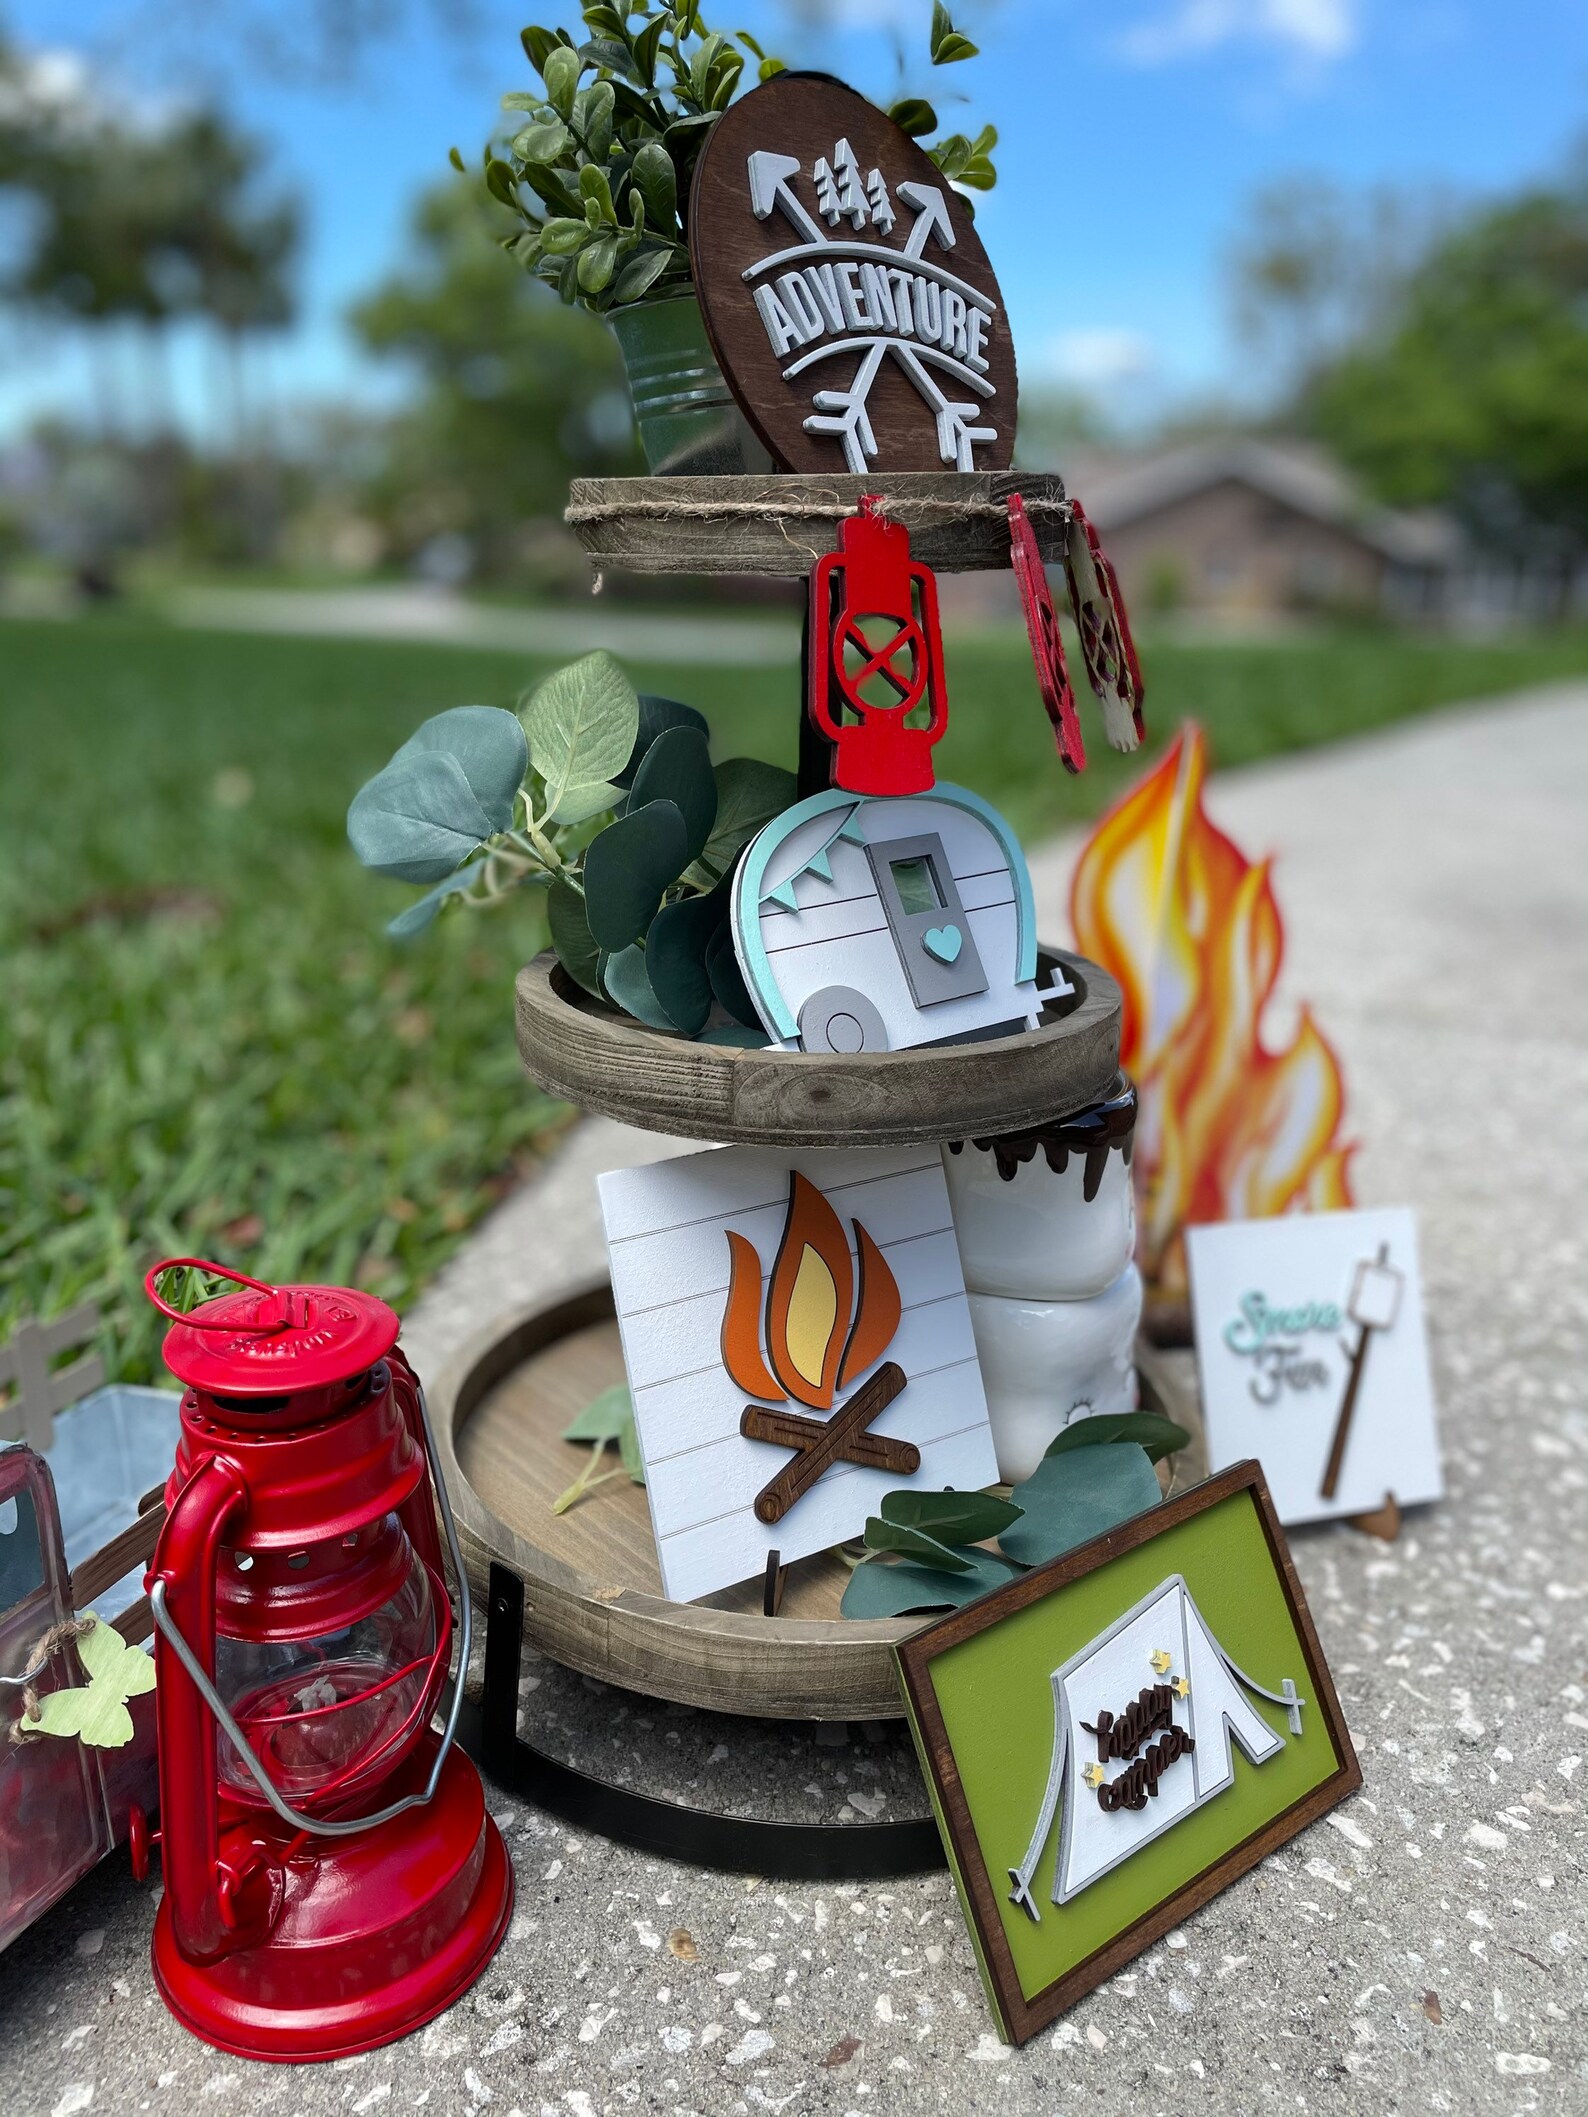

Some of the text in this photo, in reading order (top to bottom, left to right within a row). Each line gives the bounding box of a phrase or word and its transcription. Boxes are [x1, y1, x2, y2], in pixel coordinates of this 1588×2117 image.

[753, 262, 992, 374] ADVENTURE
[1079, 1683, 1173, 1763] happy
[1097, 1725, 1195, 1812] camper
